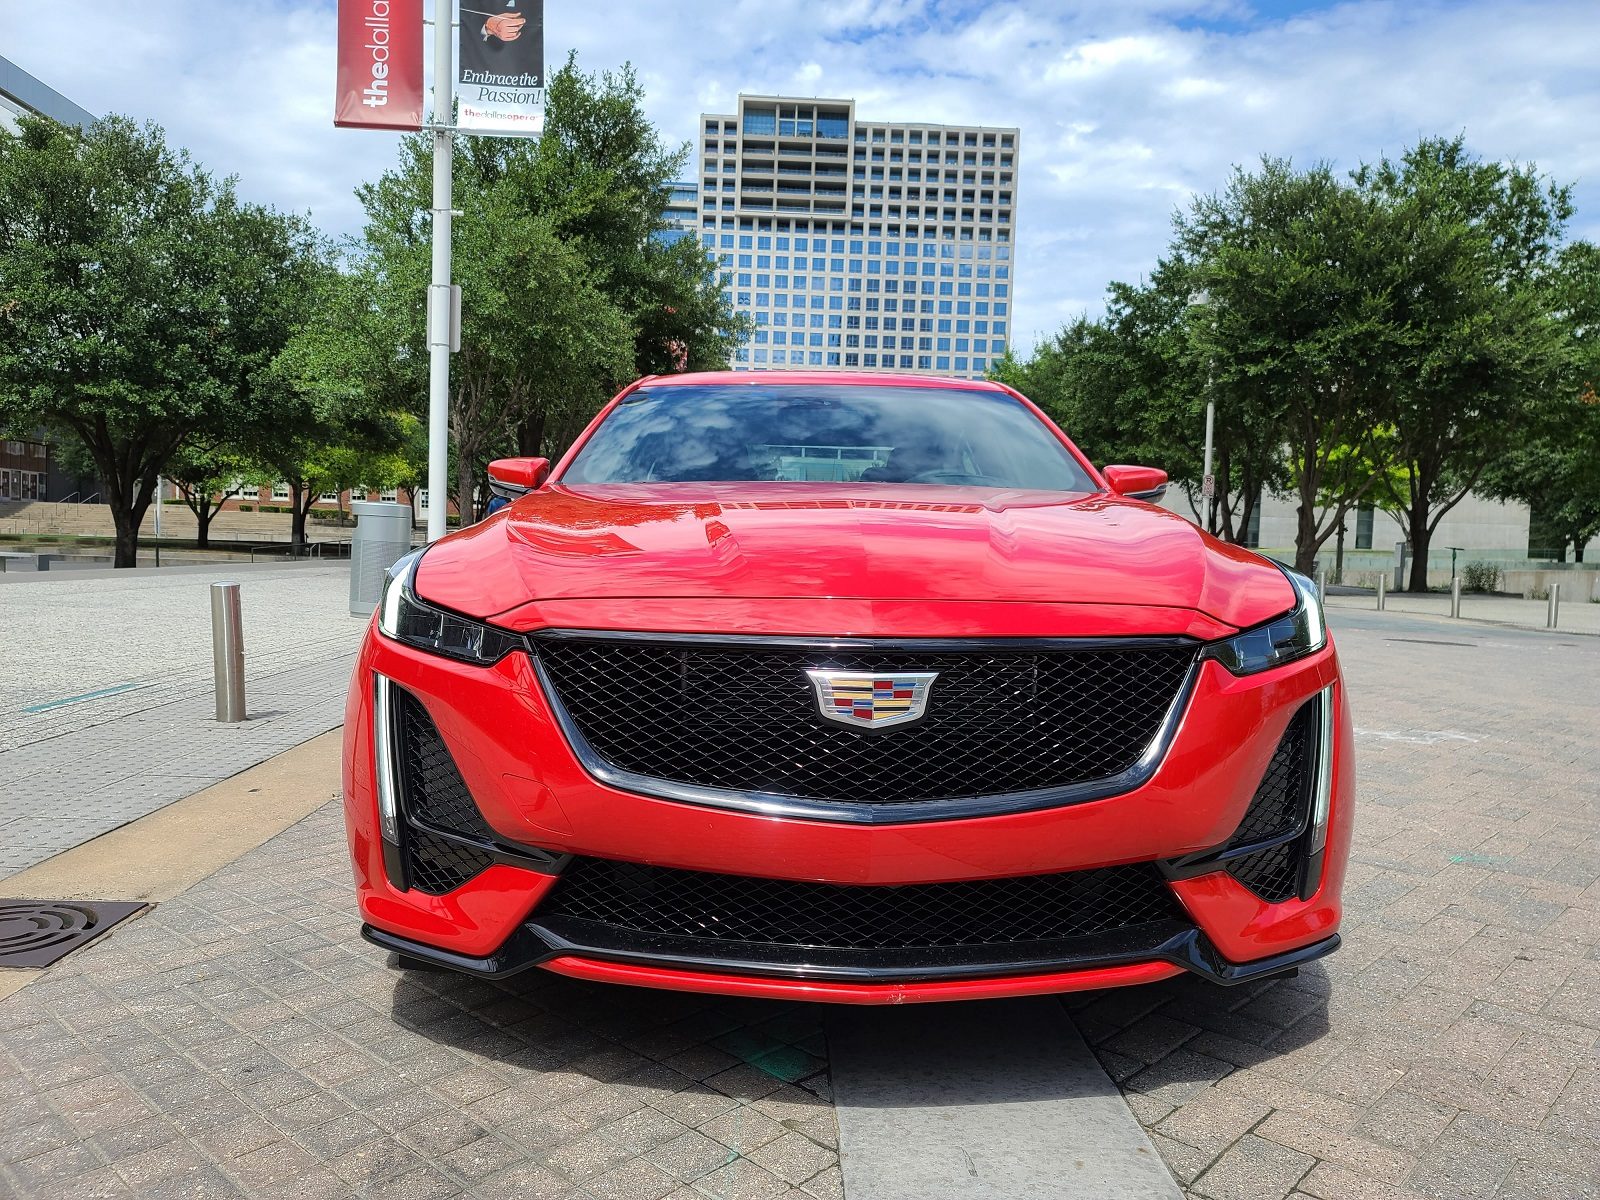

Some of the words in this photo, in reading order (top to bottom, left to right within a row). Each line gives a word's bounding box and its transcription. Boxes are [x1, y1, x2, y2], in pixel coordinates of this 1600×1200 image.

[462, 69, 518, 85] Embrace
[519, 72, 538, 86] the
[476, 86, 542, 104] Passion!
